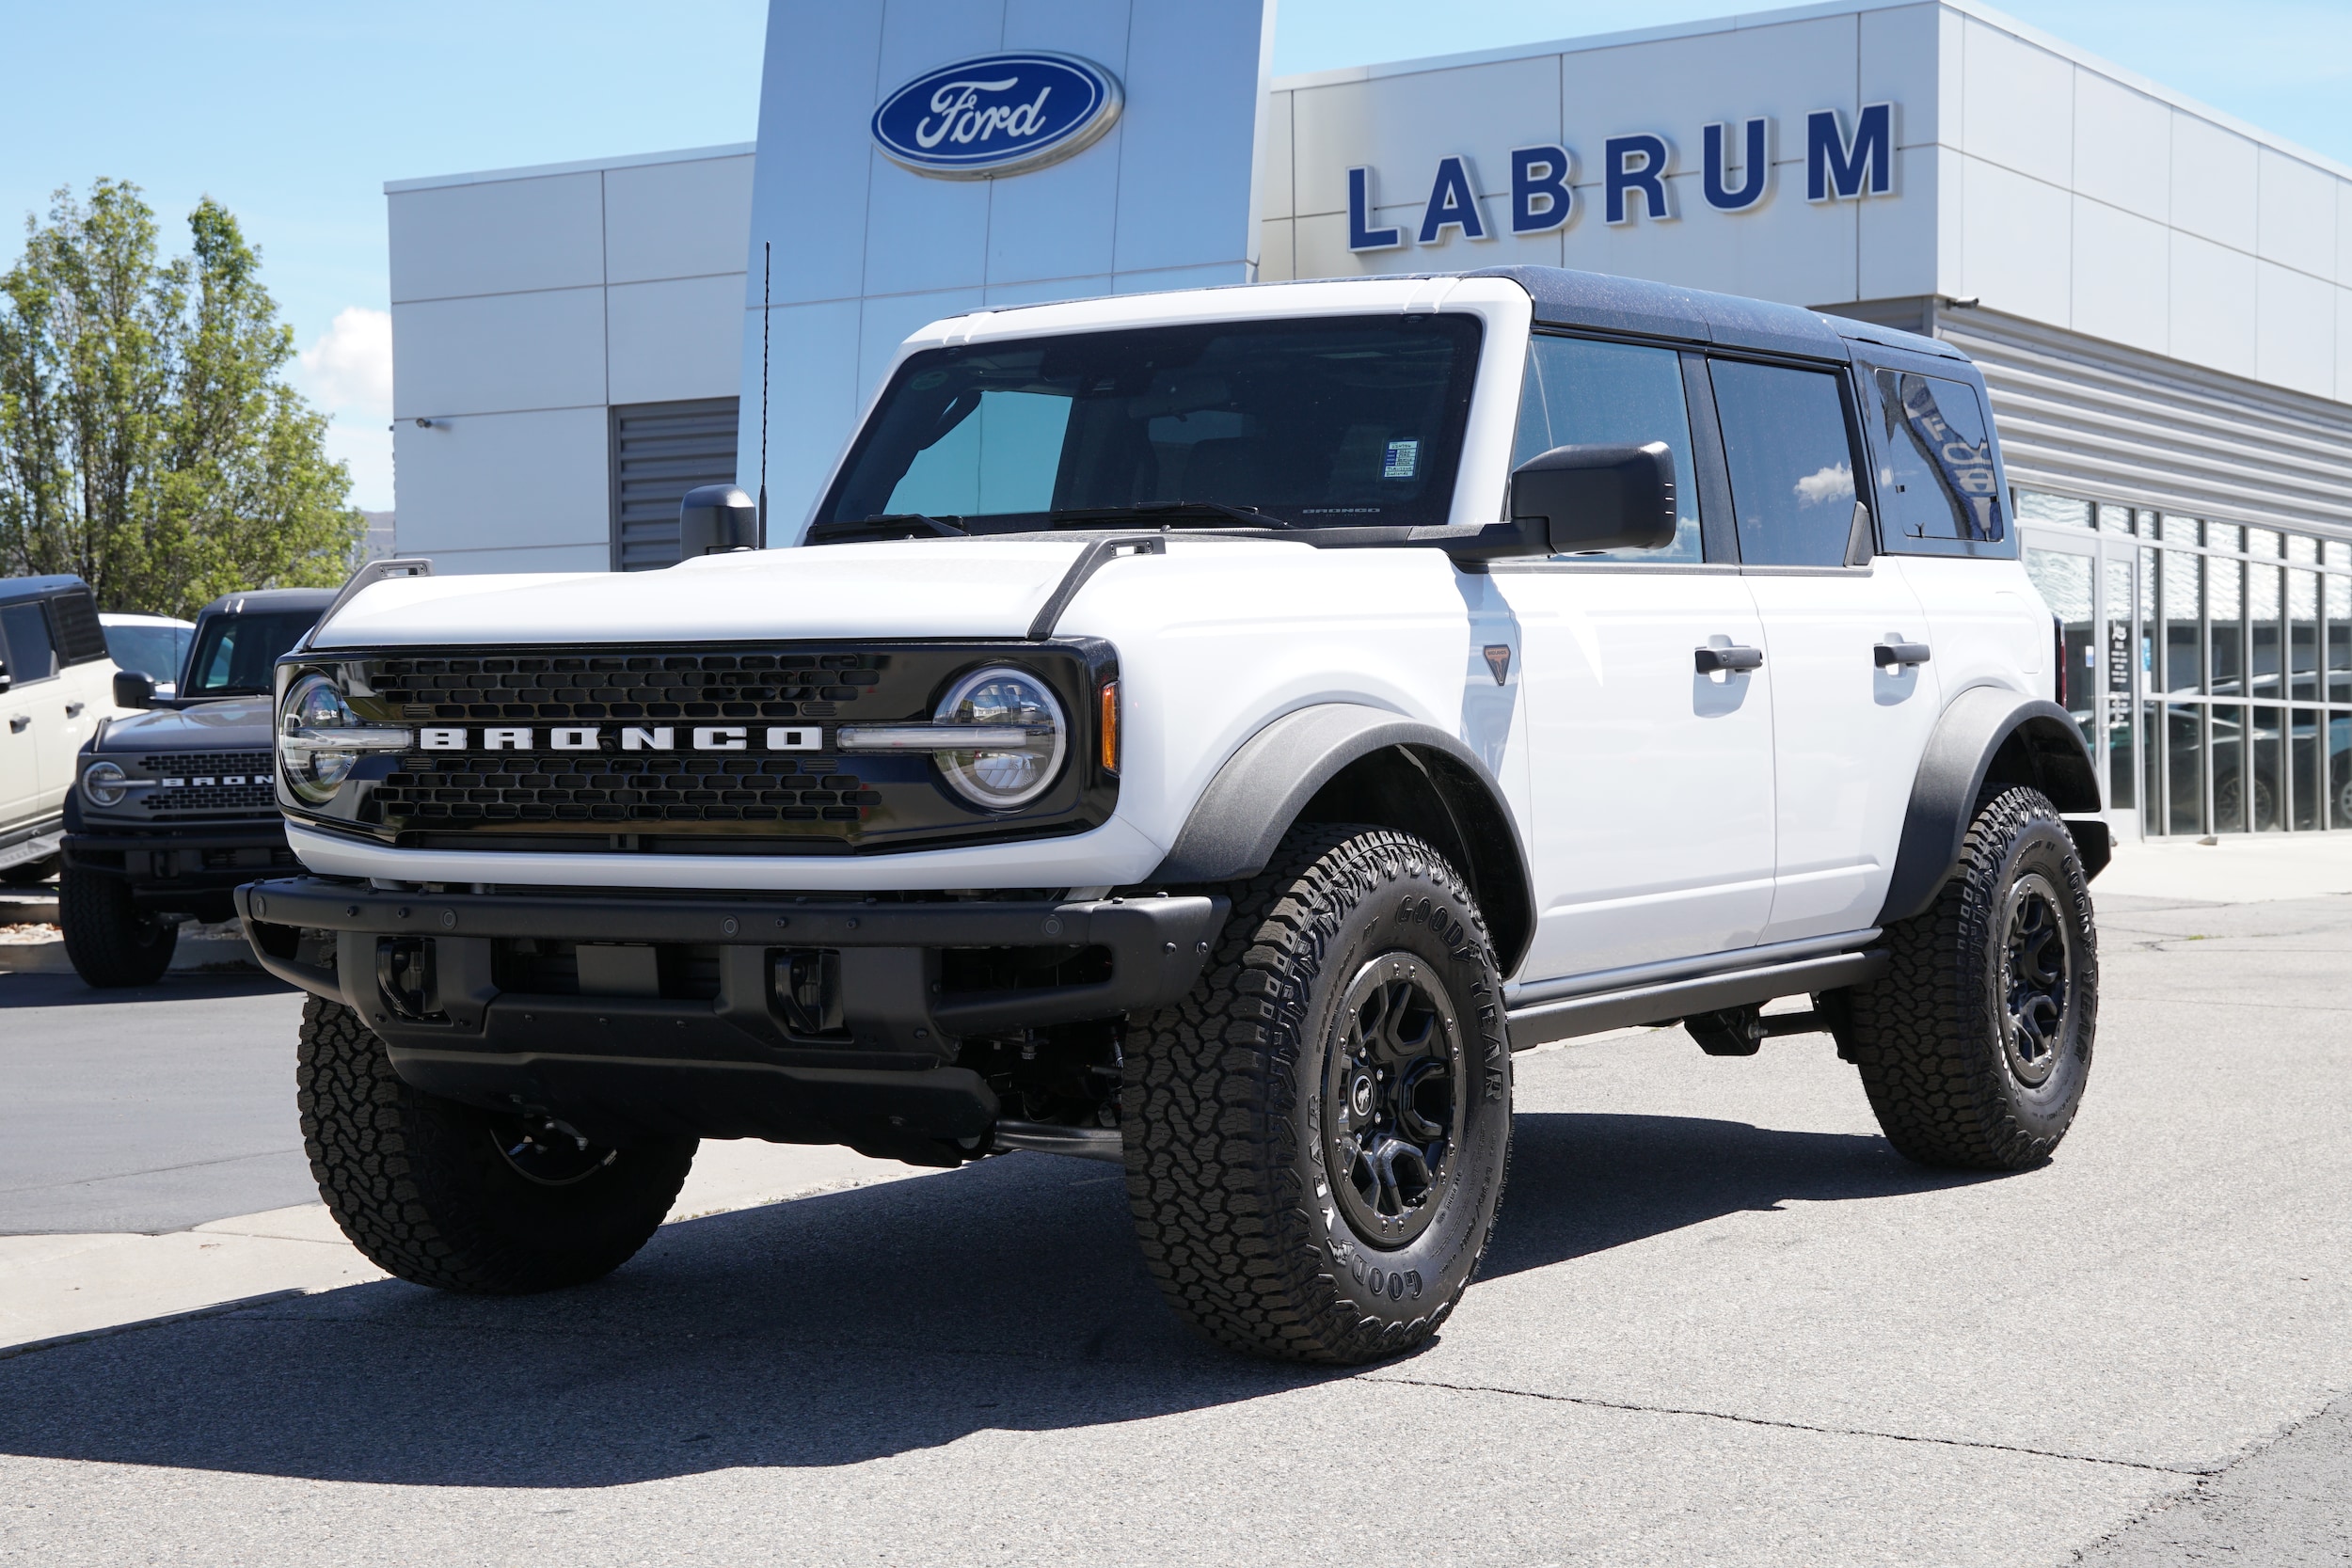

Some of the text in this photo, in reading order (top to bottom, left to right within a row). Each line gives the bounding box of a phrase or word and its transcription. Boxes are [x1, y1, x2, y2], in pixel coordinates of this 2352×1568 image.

[915, 77, 1052, 148] Ford
[1346, 101, 1899, 253] LABRUM
[420, 726, 823, 751] BRONCO
